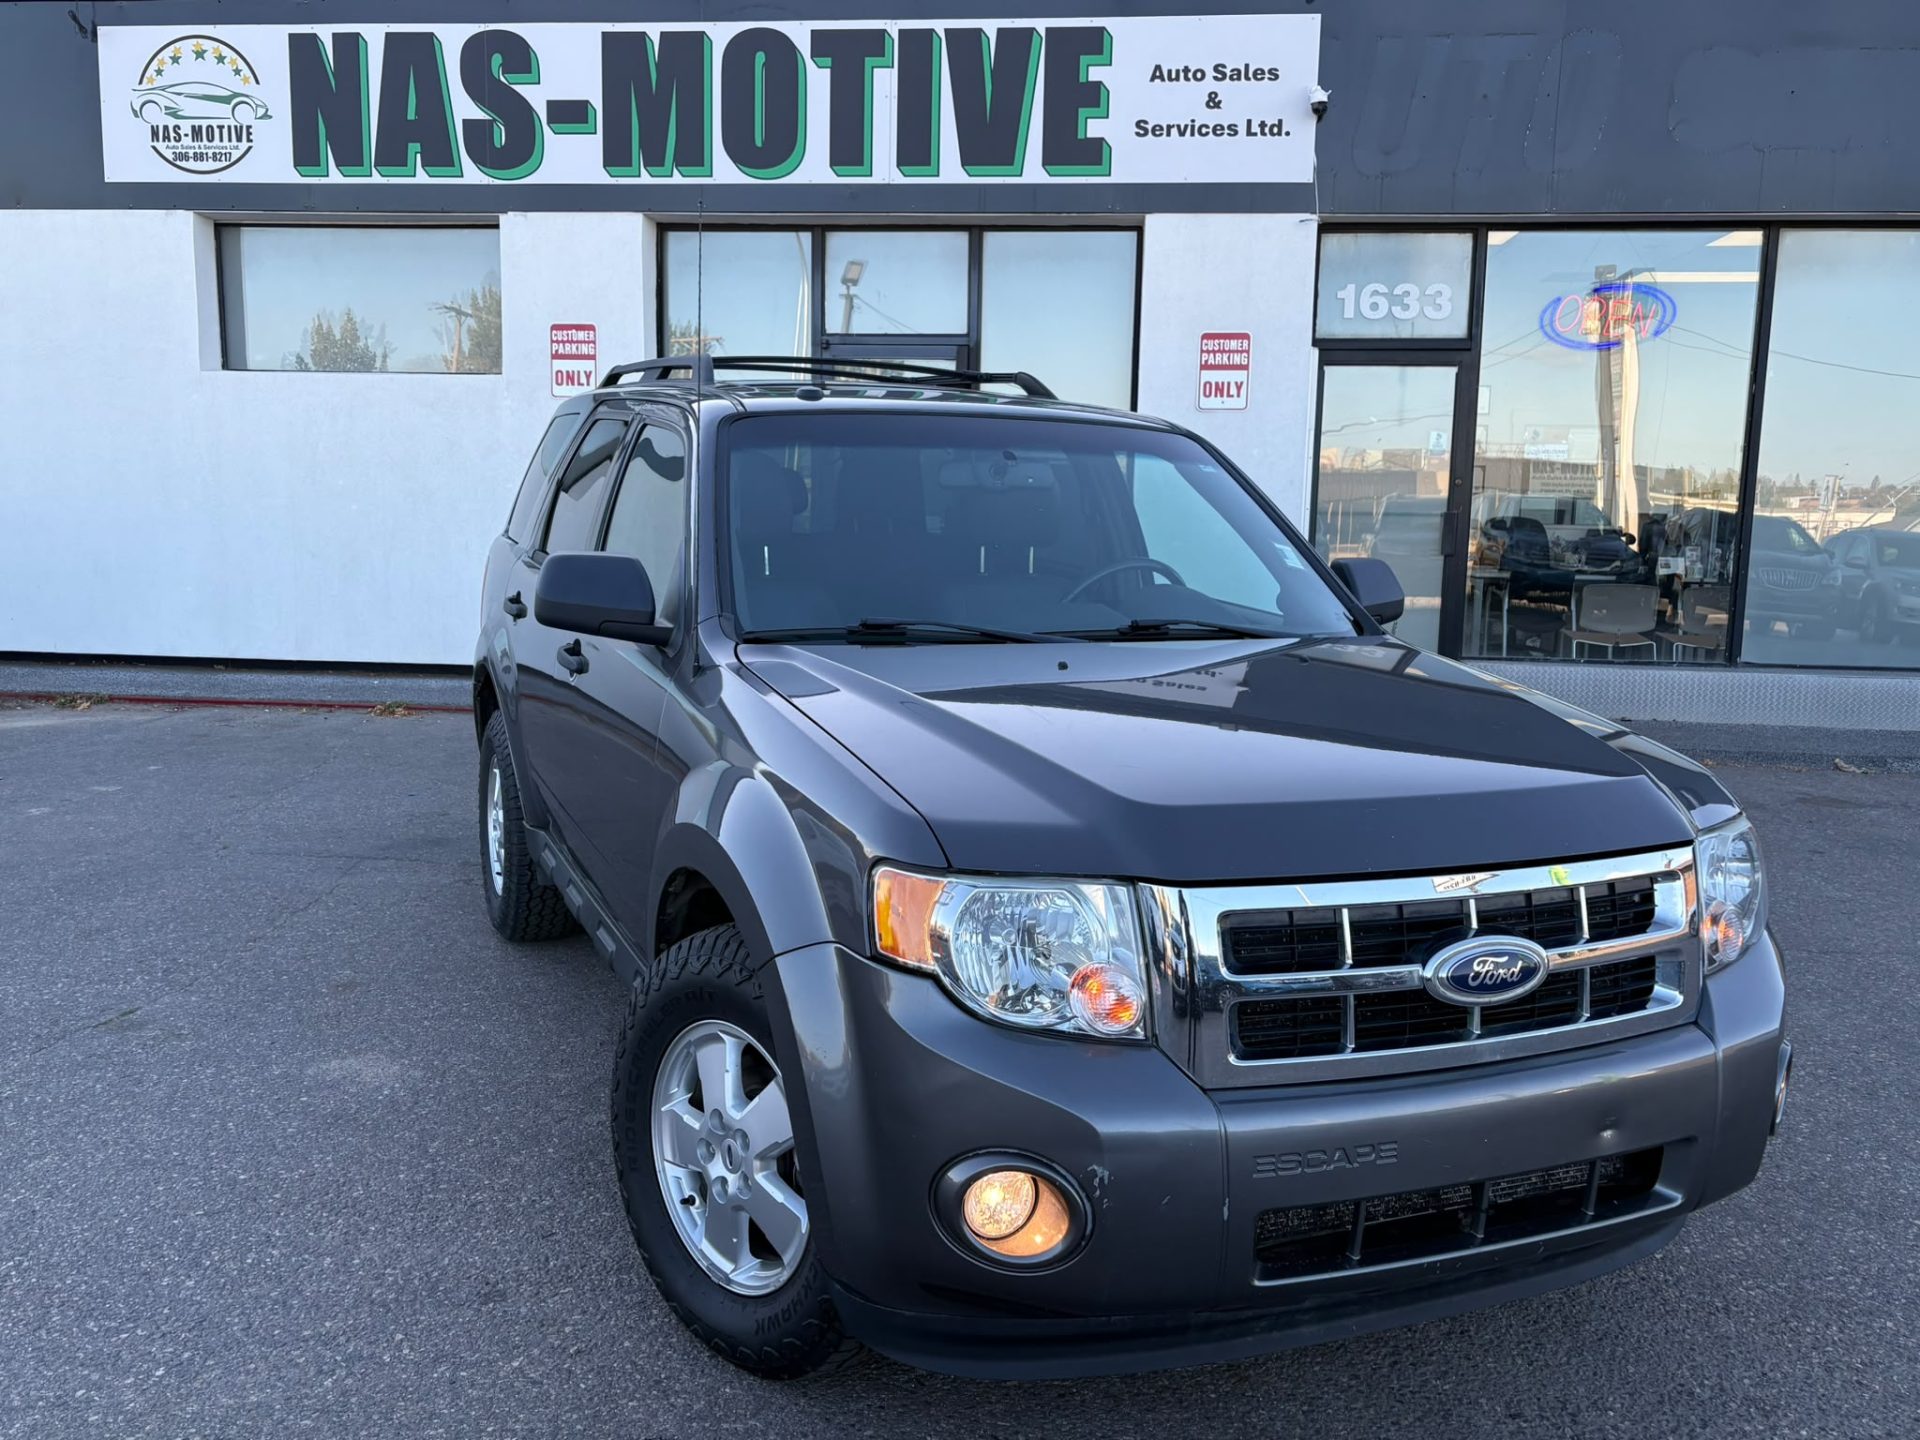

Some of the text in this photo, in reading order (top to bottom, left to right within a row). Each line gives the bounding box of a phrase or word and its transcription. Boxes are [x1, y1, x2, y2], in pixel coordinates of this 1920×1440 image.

[1149, 63, 1280, 82] Auto Sales
[288, 26, 1113, 180] NAS-MOTIVE
[1205, 91, 1222, 110] &
[150, 124, 253, 143] NAS-MOTIVE
[1134, 118, 1291, 137] Services Ltd.
[172, 151, 232, 162] 306-881-8217
[1336, 283, 1452, 320] 1633
[1555, 295, 1656, 338] OPEN
[552, 330, 595, 341] CUSTOMER
[1202, 339, 1249, 351] CUSTOMER
[552, 343, 595, 355] PARKING
[1201, 353, 1248, 365] PARKING
[555, 369, 592, 386] ONLY
[1203, 381, 1244, 398] ONLY
[1468, 956, 1523, 987] Ford
[1252, 1140, 1398, 1178] ESCAPE
